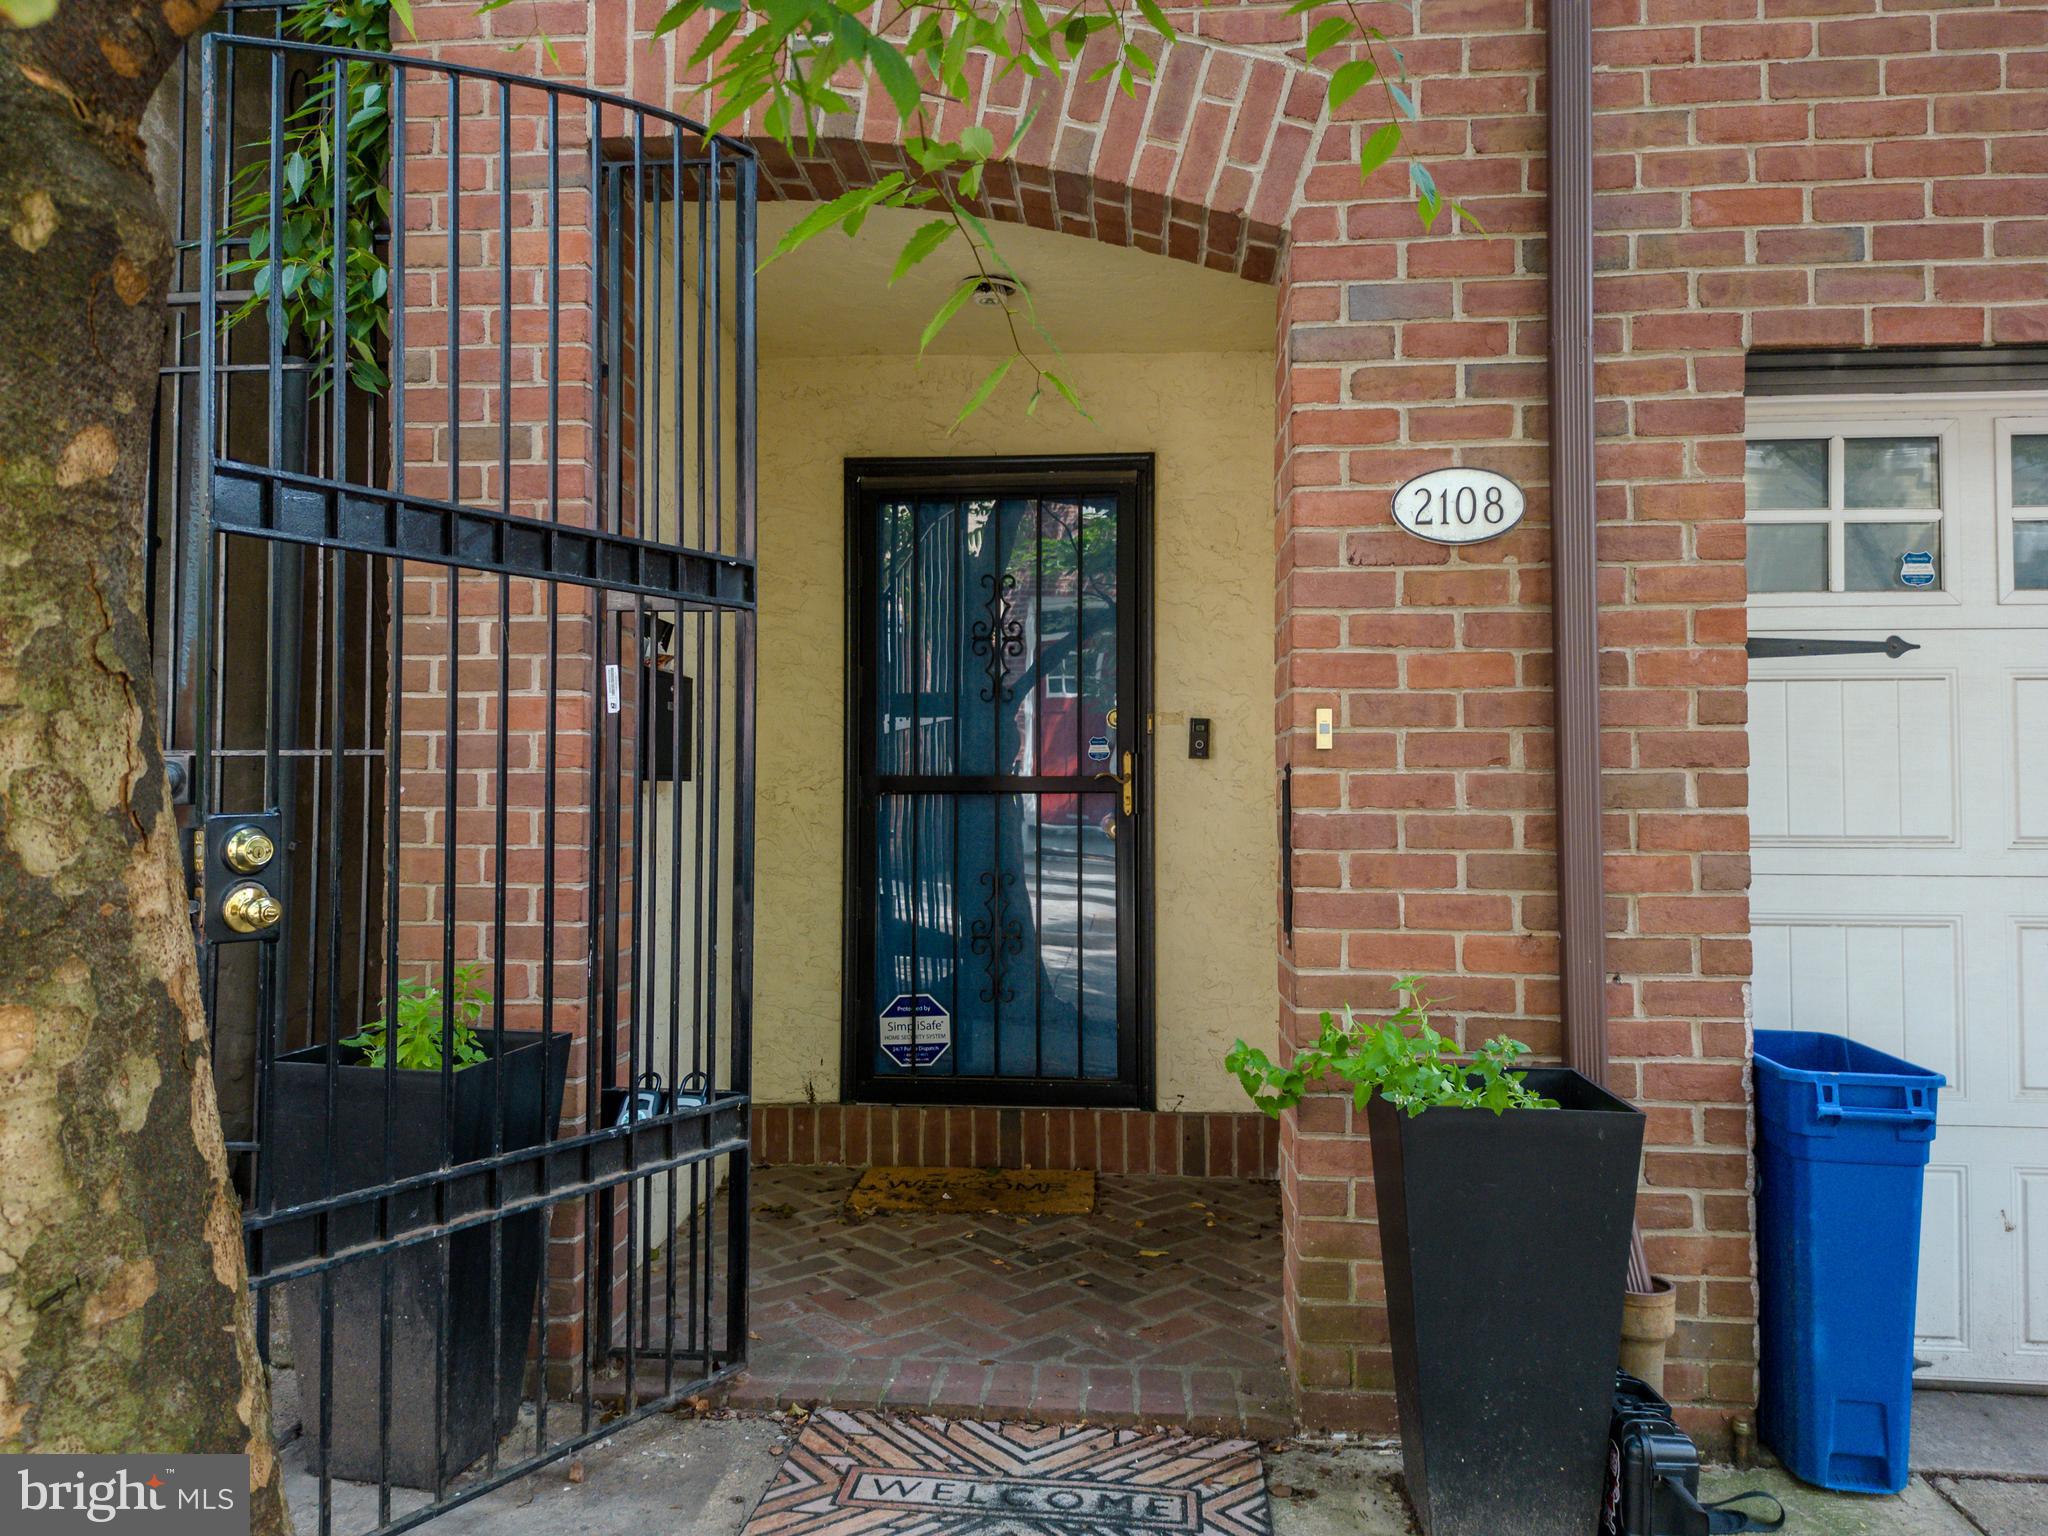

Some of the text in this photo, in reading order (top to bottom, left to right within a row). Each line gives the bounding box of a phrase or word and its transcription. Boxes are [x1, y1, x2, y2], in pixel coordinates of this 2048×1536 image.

[1414, 486, 1504, 525] 2108
[887, 1020, 942, 1033] SimpiSafe
[872, 1477, 1174, 1517] WELCOME
